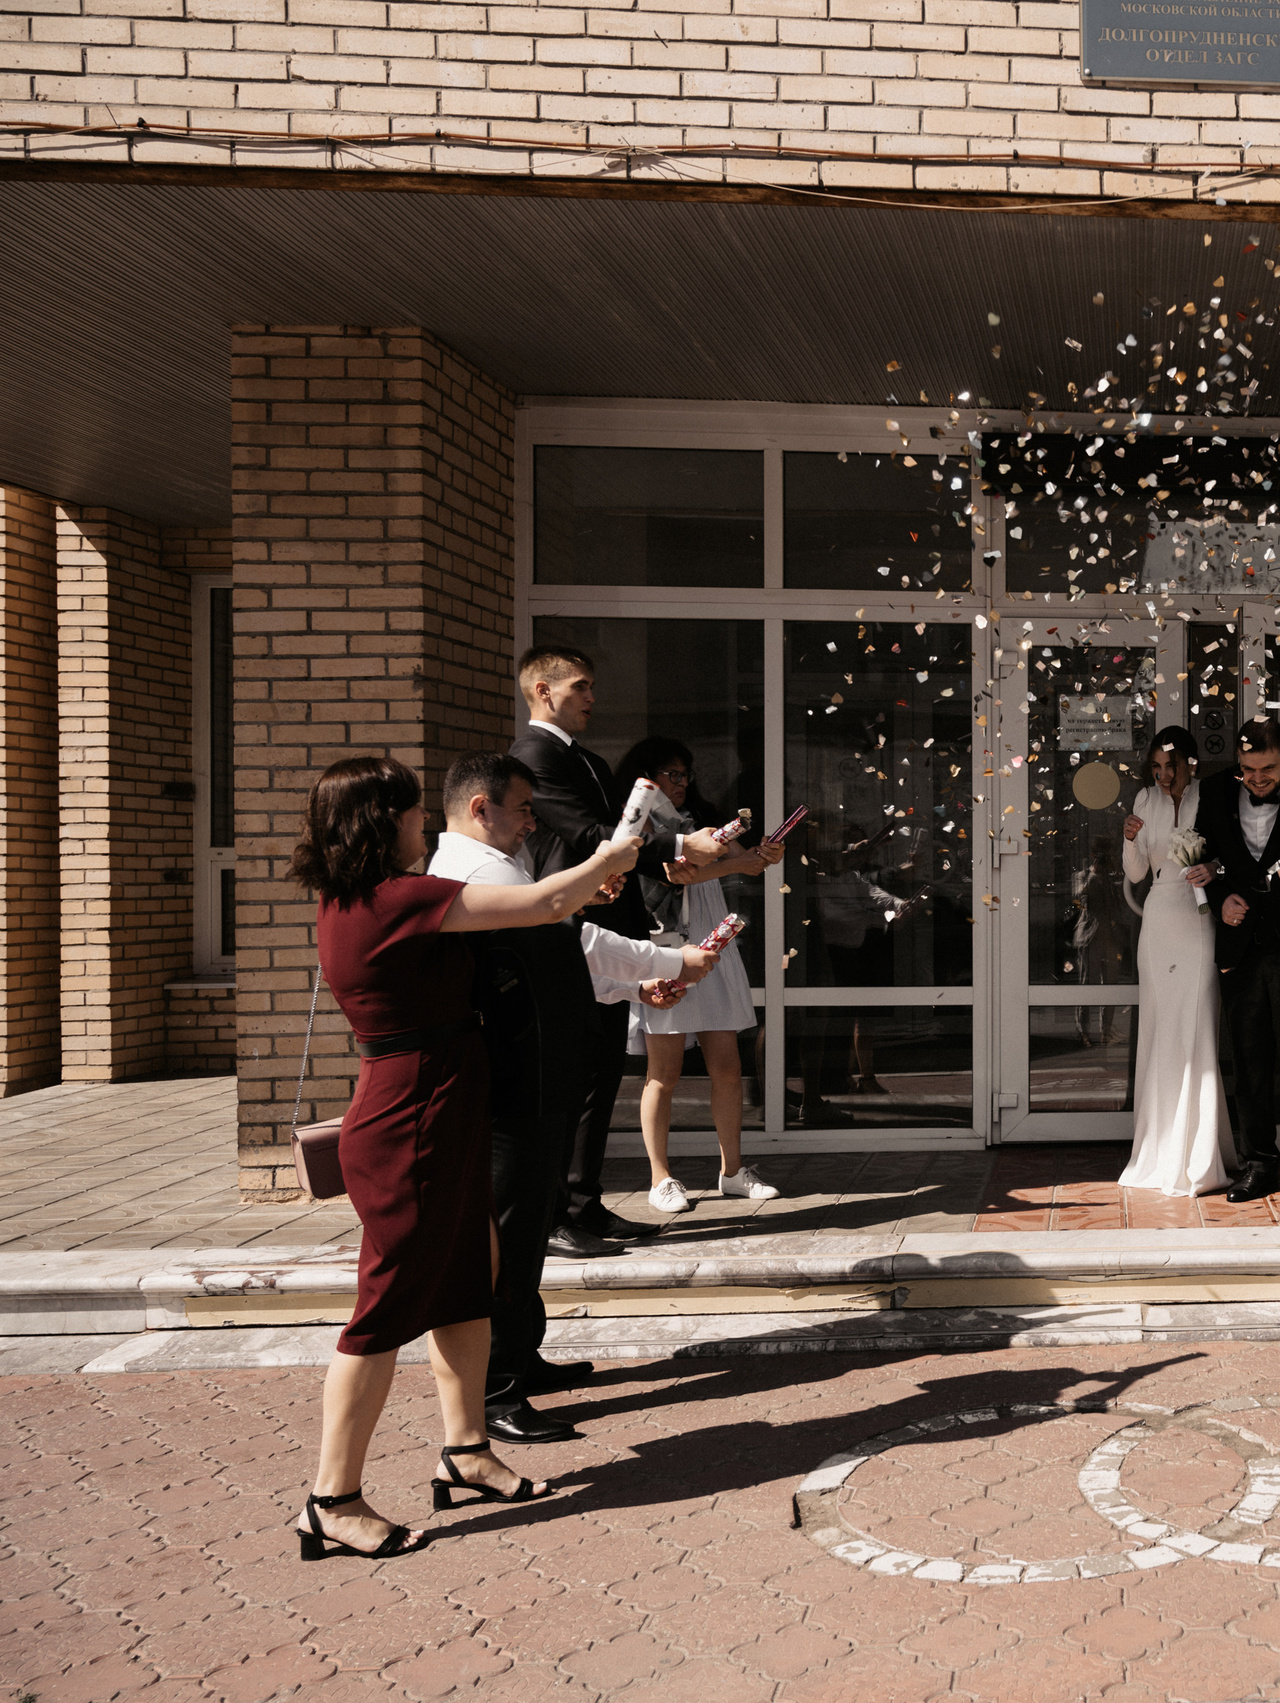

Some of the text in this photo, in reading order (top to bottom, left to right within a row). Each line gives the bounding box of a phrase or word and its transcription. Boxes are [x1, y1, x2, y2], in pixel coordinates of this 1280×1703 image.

[1120, 3, 1218, 16] МОСКОВСКОЙ
[1146, 48, 1260, 65] ОТДЕЛ ЗАГС
